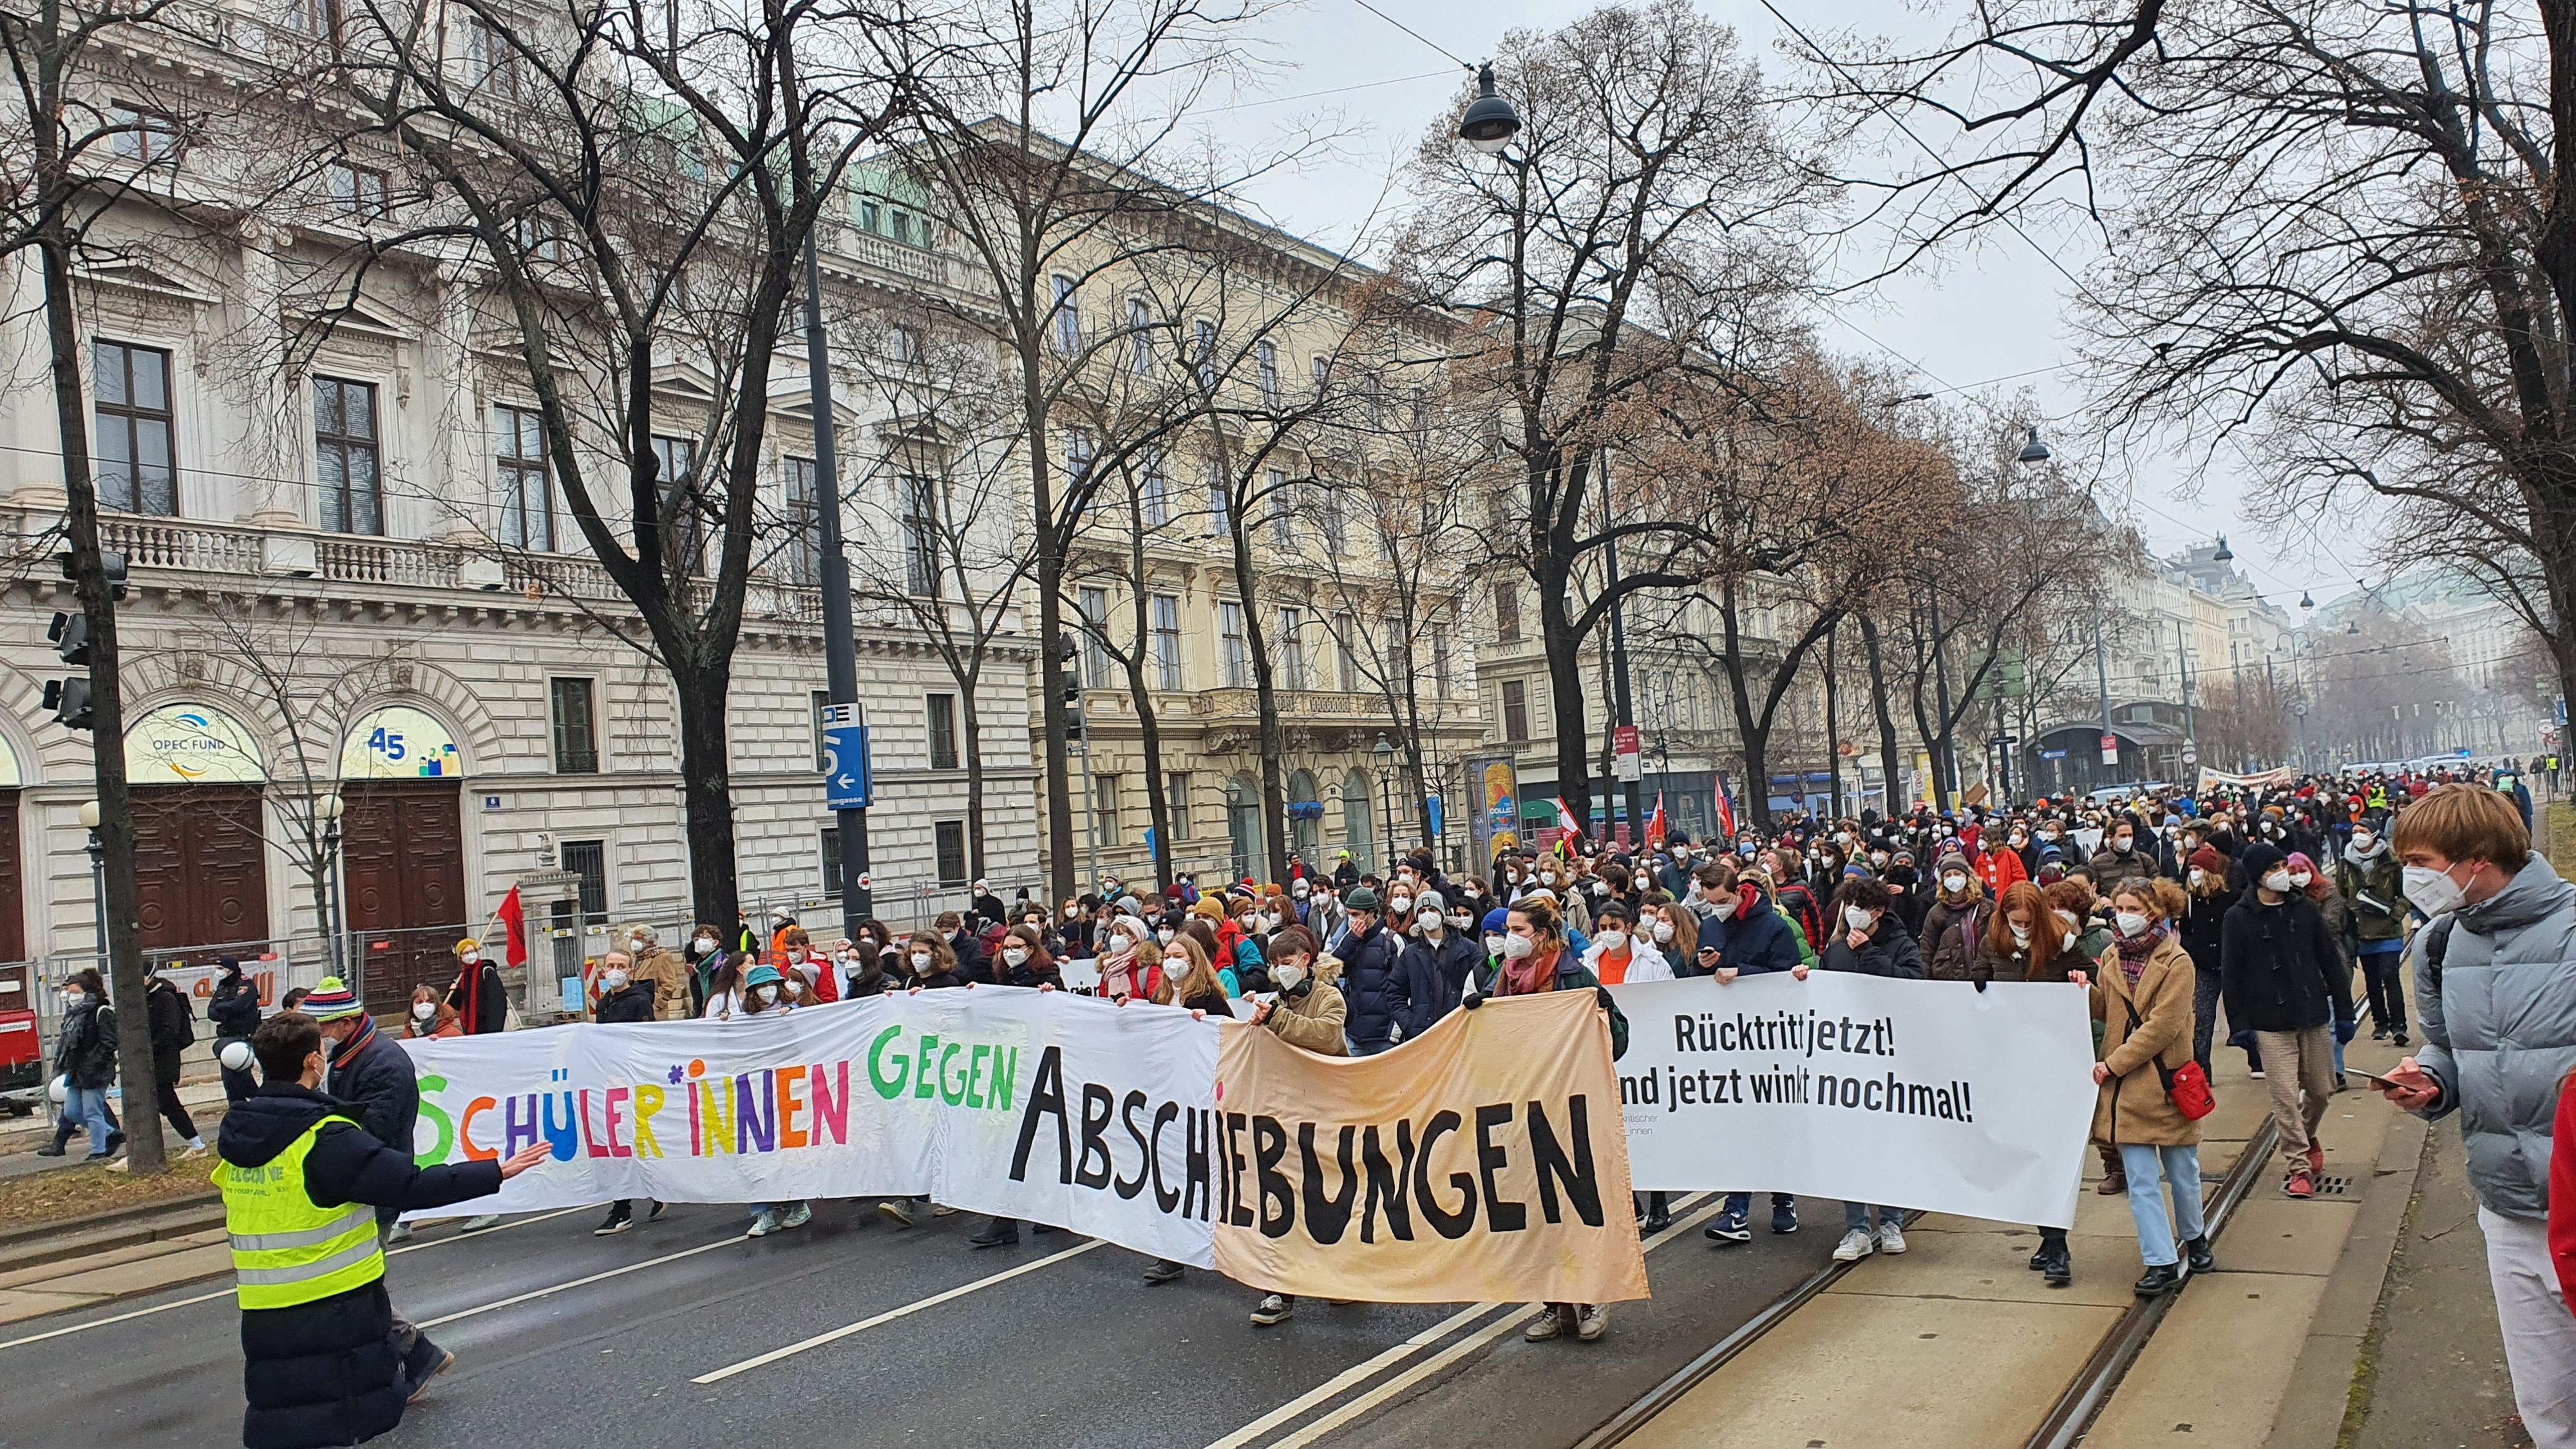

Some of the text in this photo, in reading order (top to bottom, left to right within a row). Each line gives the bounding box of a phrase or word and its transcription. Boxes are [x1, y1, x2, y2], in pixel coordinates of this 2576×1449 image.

[153, 739, 225, 750] OPEC FUND
[368, 727, 405, 760] 45
[1674, 1009, 1895, 1059] Rücktritt jetzt!
[867, 1025, 1018, 1112] GEGEN
[1619, 1063, 1973, 1123] nd jetzt winkt nochmal!
